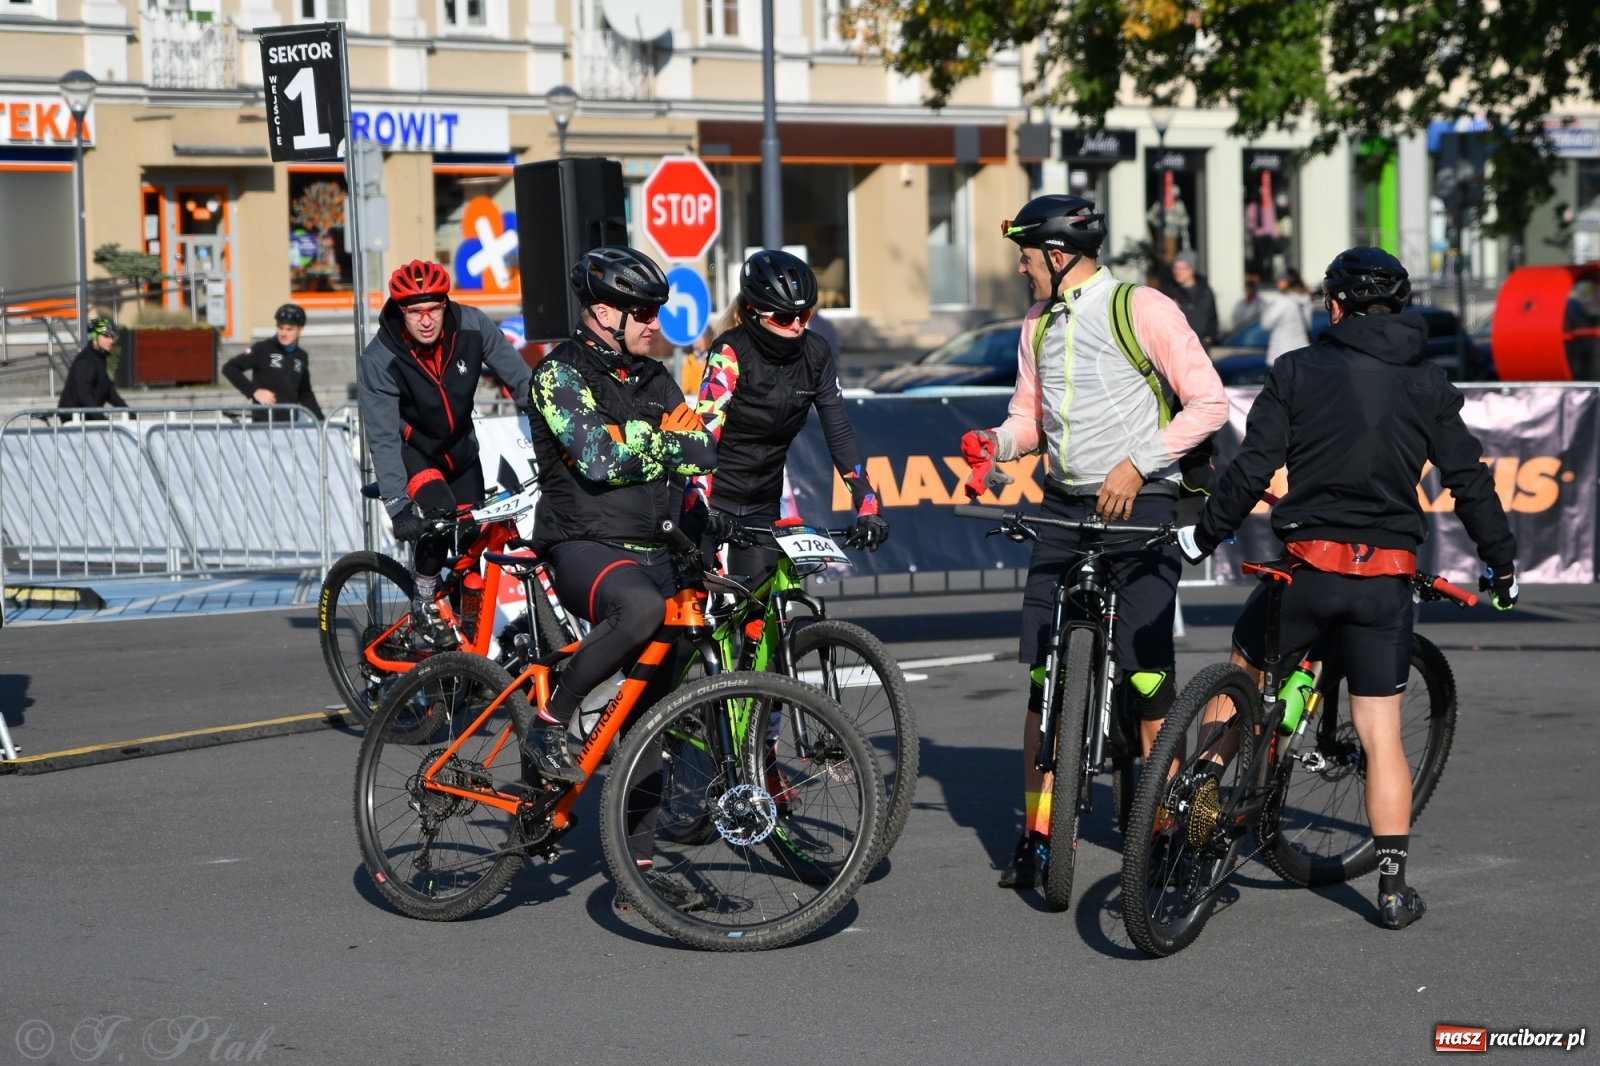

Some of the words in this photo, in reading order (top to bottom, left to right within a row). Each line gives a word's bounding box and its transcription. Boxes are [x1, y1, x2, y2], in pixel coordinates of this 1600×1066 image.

[268, 42, 333, 64] SEKTOR
[0, 102, 91, 140] EKA
[284, 66, 331, 150] 1
[651, 193, 713, 226] STOP
[831, 454, 1047, 512] MAXX
[793, 539, 834, 553] 1784
[320, 588, 330, 631] MAXXIS
[666, 692, 693, 714] RAY
[697, 679, 749, 696] RACING
[747, 699, 763, 748] RACING
